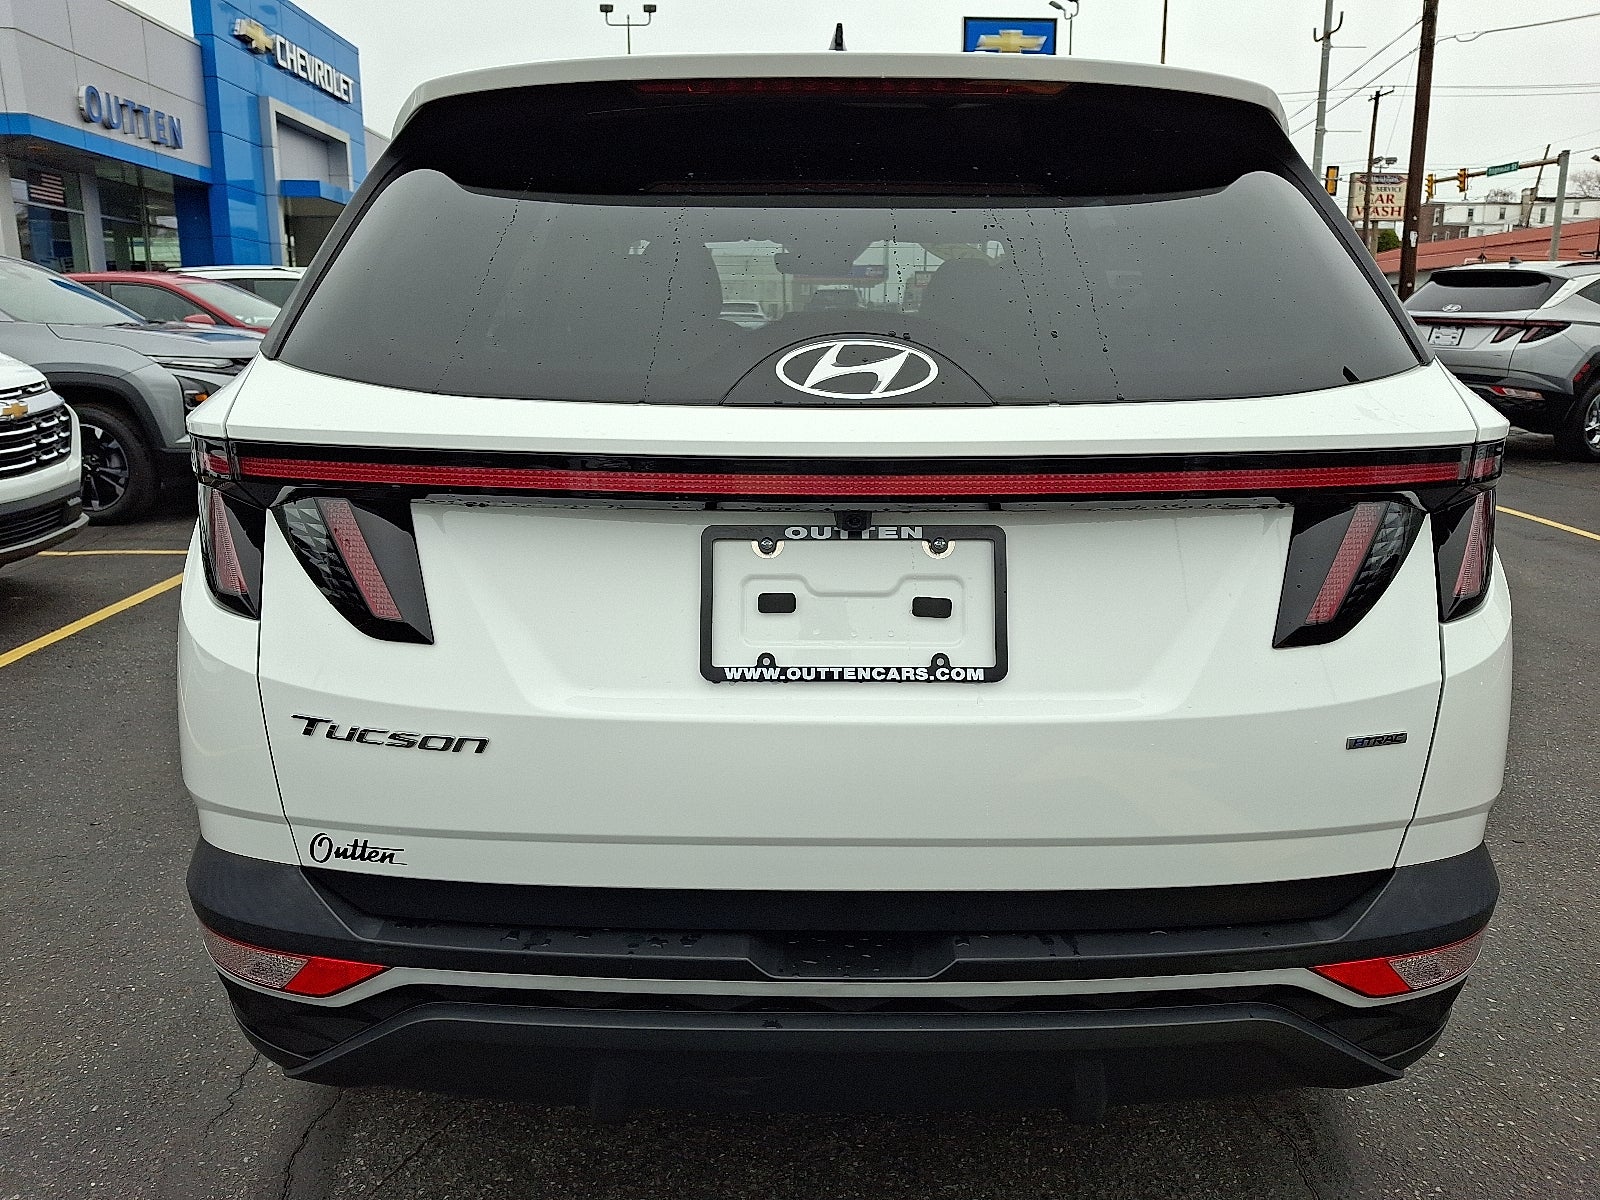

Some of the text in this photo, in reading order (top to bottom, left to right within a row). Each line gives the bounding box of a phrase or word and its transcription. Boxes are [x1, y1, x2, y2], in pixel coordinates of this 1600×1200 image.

[275, 34, 354, 103] CHEVROLET
[78, 85, 184, 149] OUTTEN
[784, 526, 923, 540] OUTTEN
[724, 667, 985, 681] WWW.OUTTENCARS.COM
[309, 832, 408, 865] Outten
